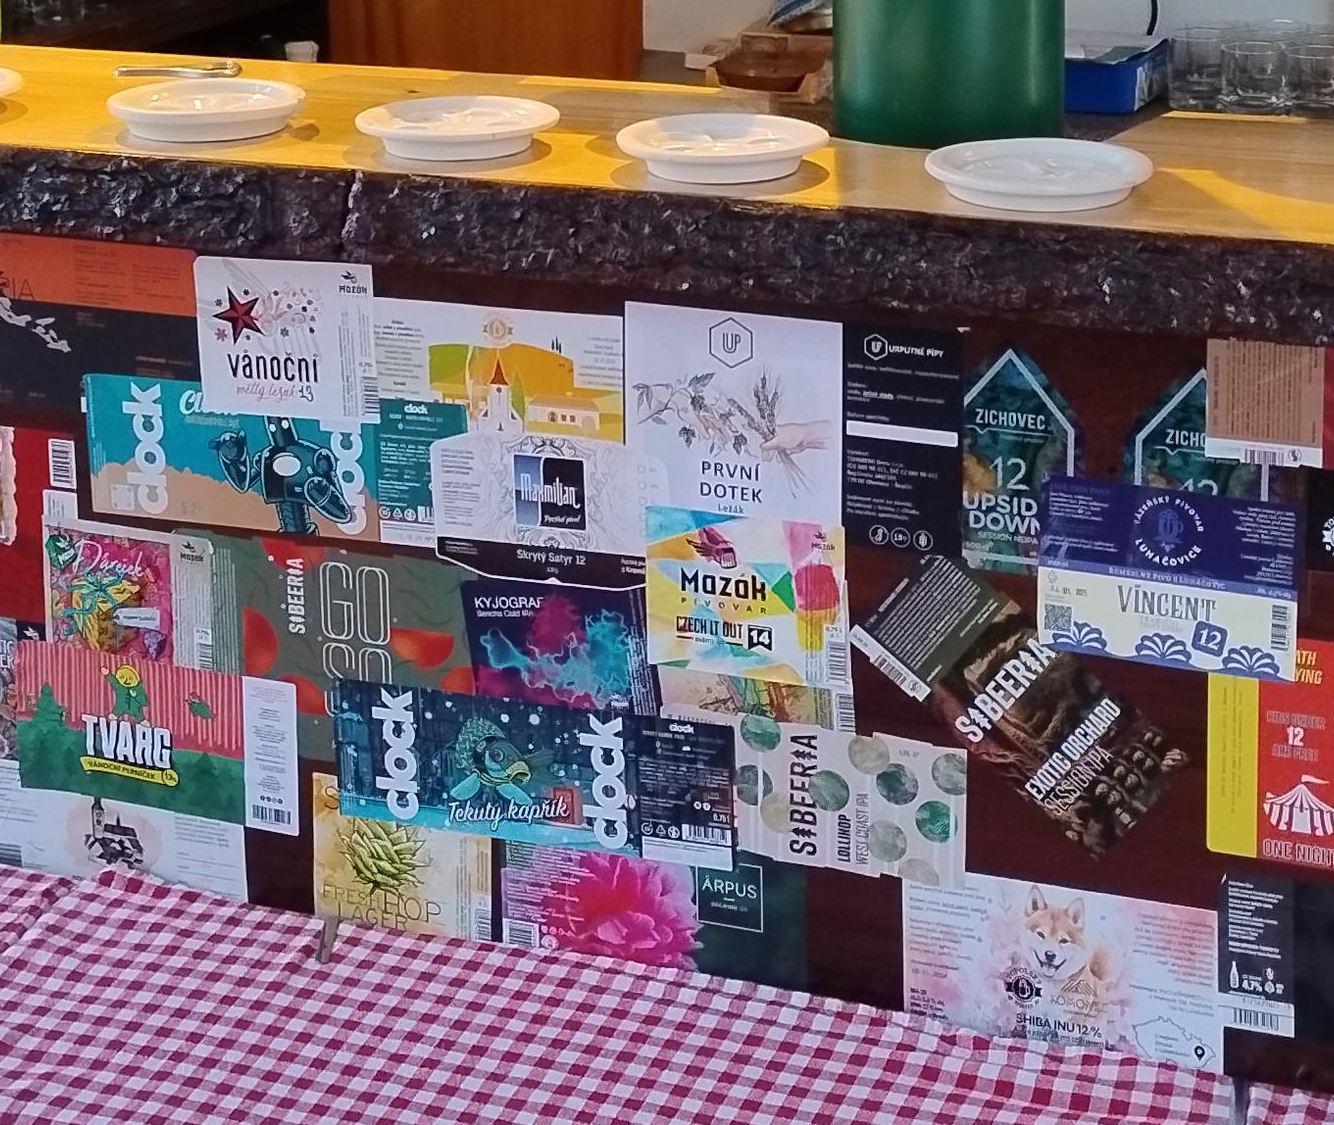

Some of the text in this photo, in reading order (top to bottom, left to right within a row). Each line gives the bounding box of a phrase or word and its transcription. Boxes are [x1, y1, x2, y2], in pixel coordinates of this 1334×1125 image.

[227, 348, 320, 383] vánoční
[975, 408, 1046, 431] ZICHOVEC
[123, 381, 168, 516] clock
[701, 460, 762, 482] PRVNÍ
[988, 456, 1028, 492] 12
[700, 481, 763, 504] DOTEK
[516, 548, 587, 566] Skrytý Satyr 12
[680, 596, 767, 615] PIVOVAR
[676, 615, 743, 640] CZECH OUT
[750, 630, 771, 646] 14
[1196, 629, 1222, 652] 12
[81, 714, 172, 769] TVARG
[1025, 697, 1121, 800] EXOTIC ORCHARD
[1286, 726, 1304, 747] 12
[372, 687, 420, 821] clock
[579, 713, 630, 850] clock
[1044, 765, 1097, 816] SESSION
[789, 734, 818, 856] SIBEERIA
[448, 796, 570, 831] Tekutý kapřík
[1264, 839, 1293, 859] ONE
[1015, 1013, 1075, 1033] SHIBA INU
